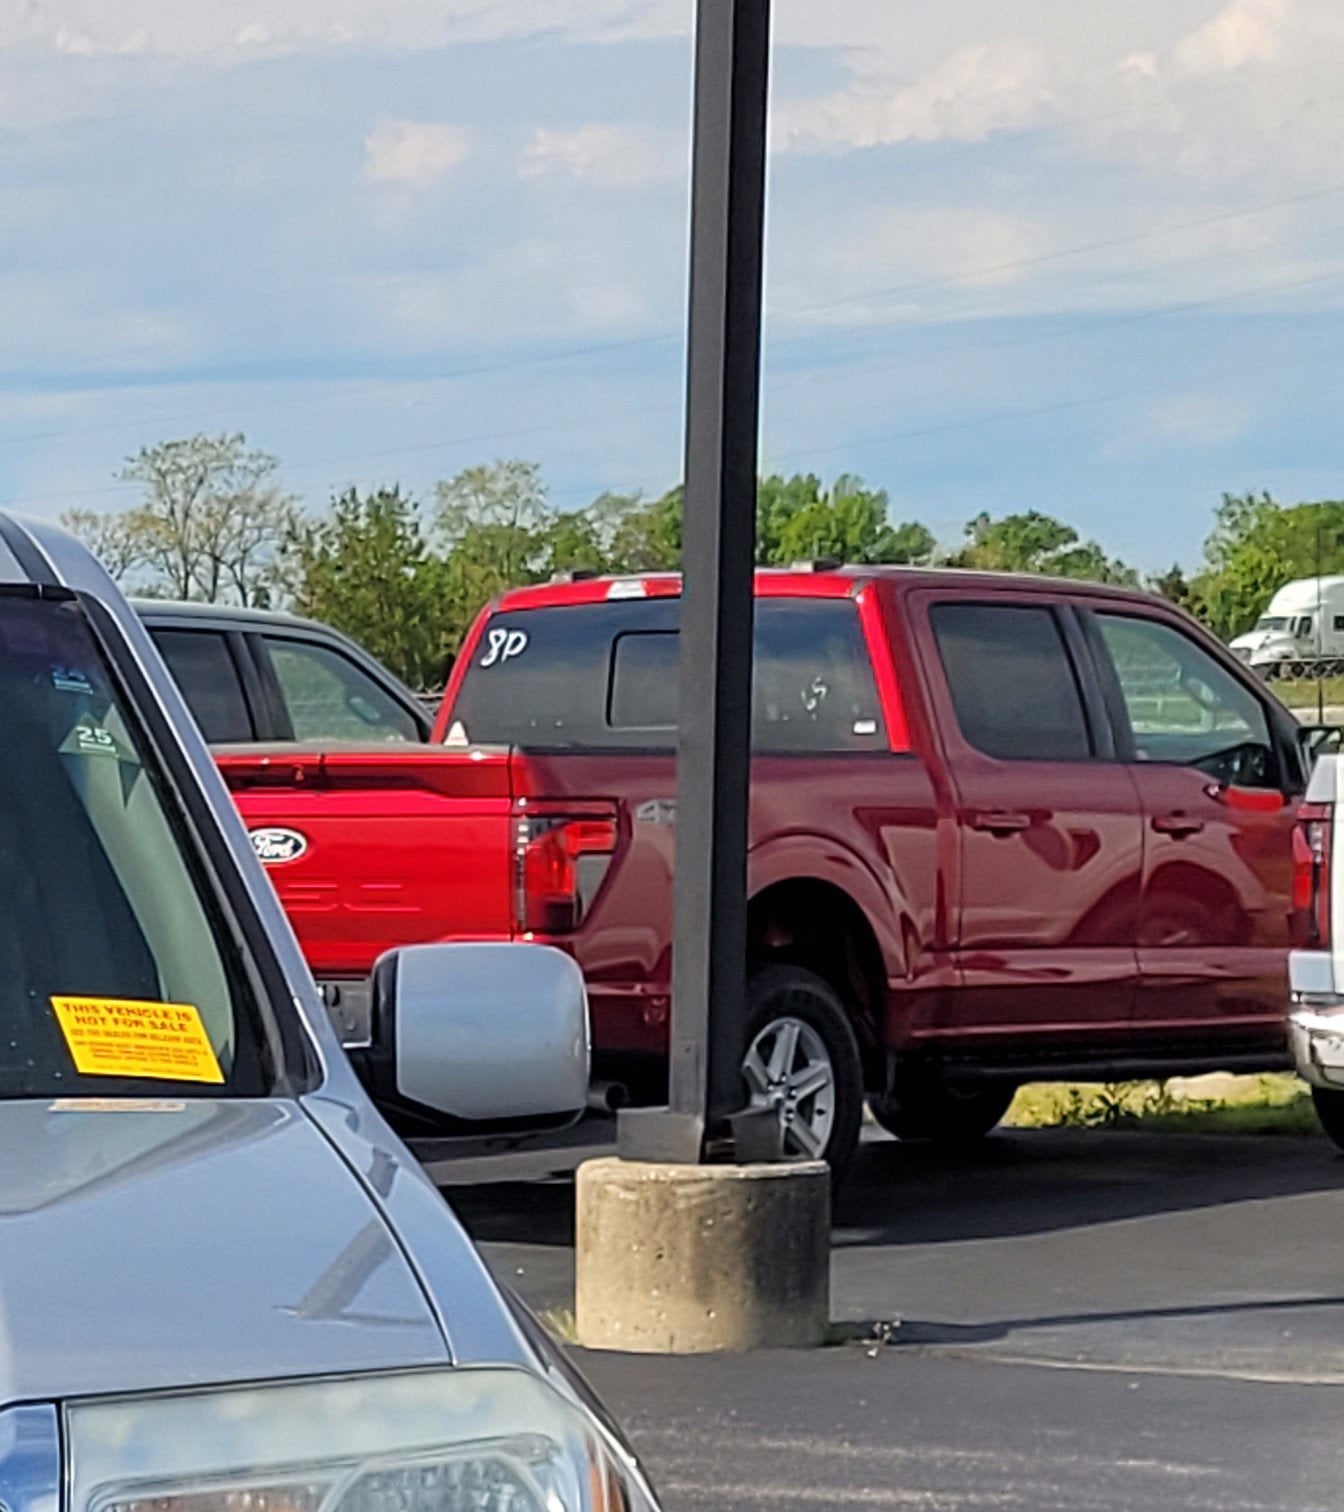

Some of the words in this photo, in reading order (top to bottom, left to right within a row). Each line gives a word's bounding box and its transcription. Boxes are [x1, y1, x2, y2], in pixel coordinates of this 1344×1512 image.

[76, 726, 112, 744] 25
[63, 1003, 99, 1014] THIS
[105, 1005, 170, 1020] VEHICLE
[176, 1011, 192, 1021] IS
[75, 1015, 107, 1026] NOT
[113, 1018, 146, 1029] FOR
[149, 1021, 188, 1033] SALE
